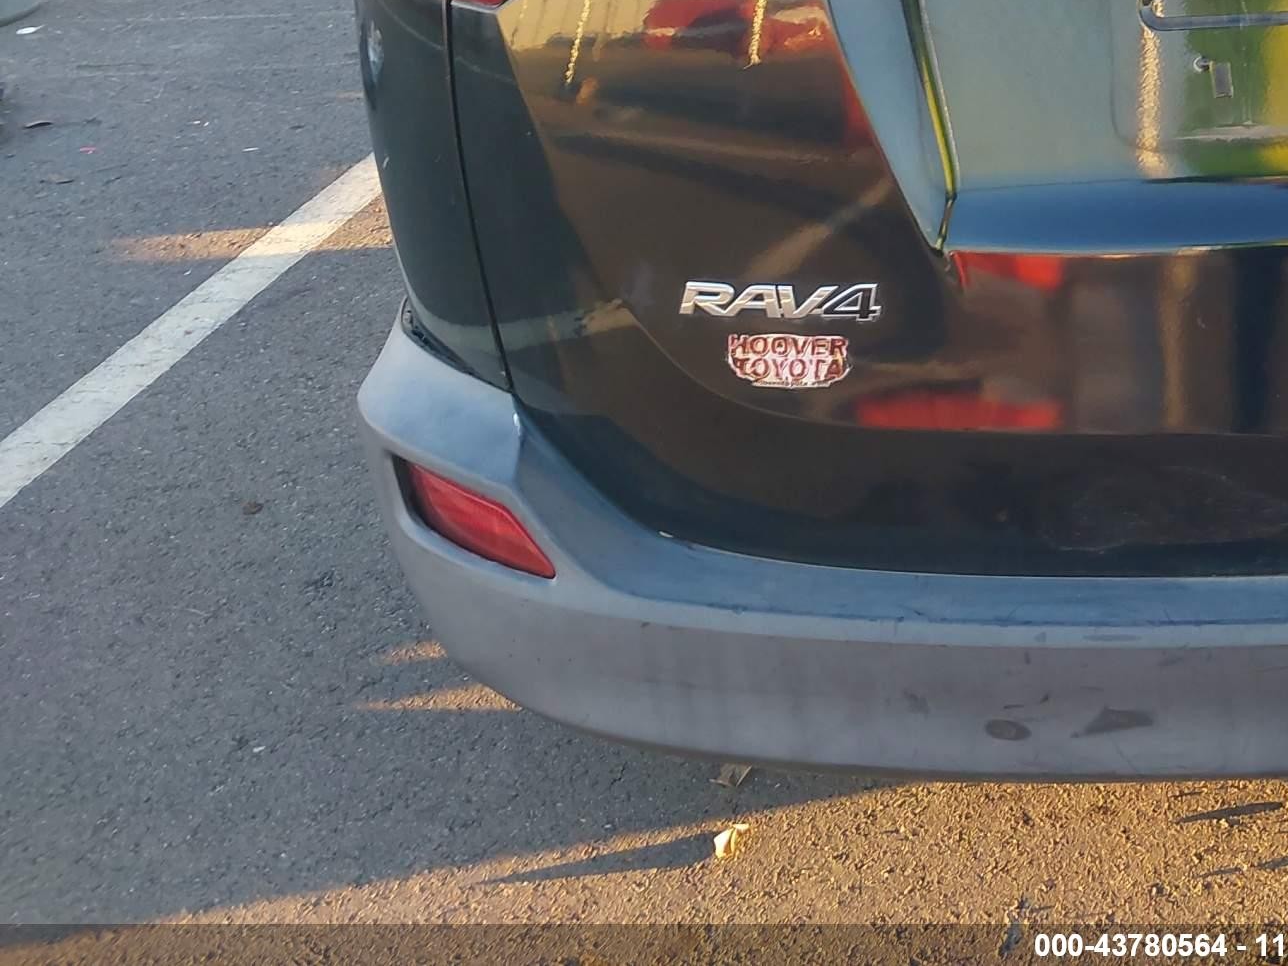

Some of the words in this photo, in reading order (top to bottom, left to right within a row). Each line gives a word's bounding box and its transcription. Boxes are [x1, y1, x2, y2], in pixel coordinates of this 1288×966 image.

[679, 281, 882, 322] RAV4
[728, 335, 846, 356] HOOVER
[733, 357, 844, 379] TOYOTA
